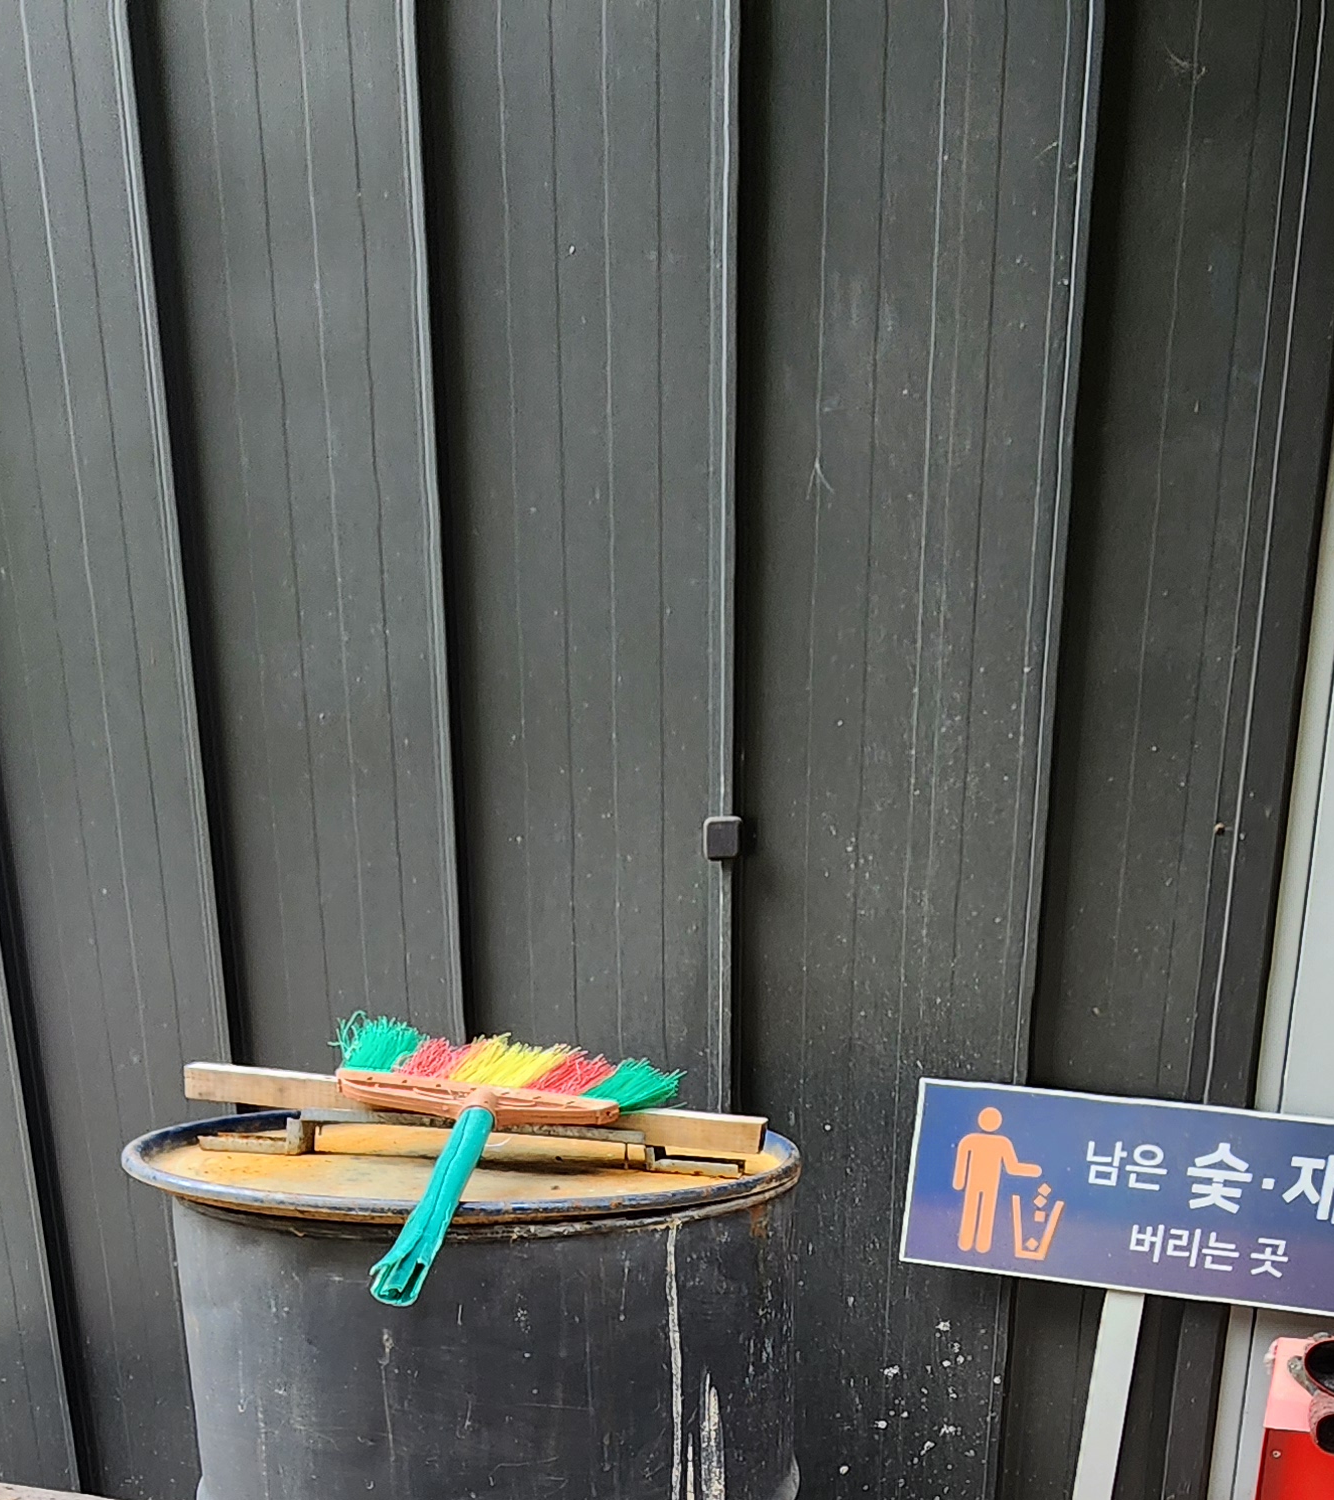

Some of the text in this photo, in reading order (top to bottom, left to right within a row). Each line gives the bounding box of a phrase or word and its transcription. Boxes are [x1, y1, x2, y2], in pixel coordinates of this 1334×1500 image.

[1086, 1140, 1168, 1191] 남은
[1129, 1224, 1289, 1278] 버리는 곳
